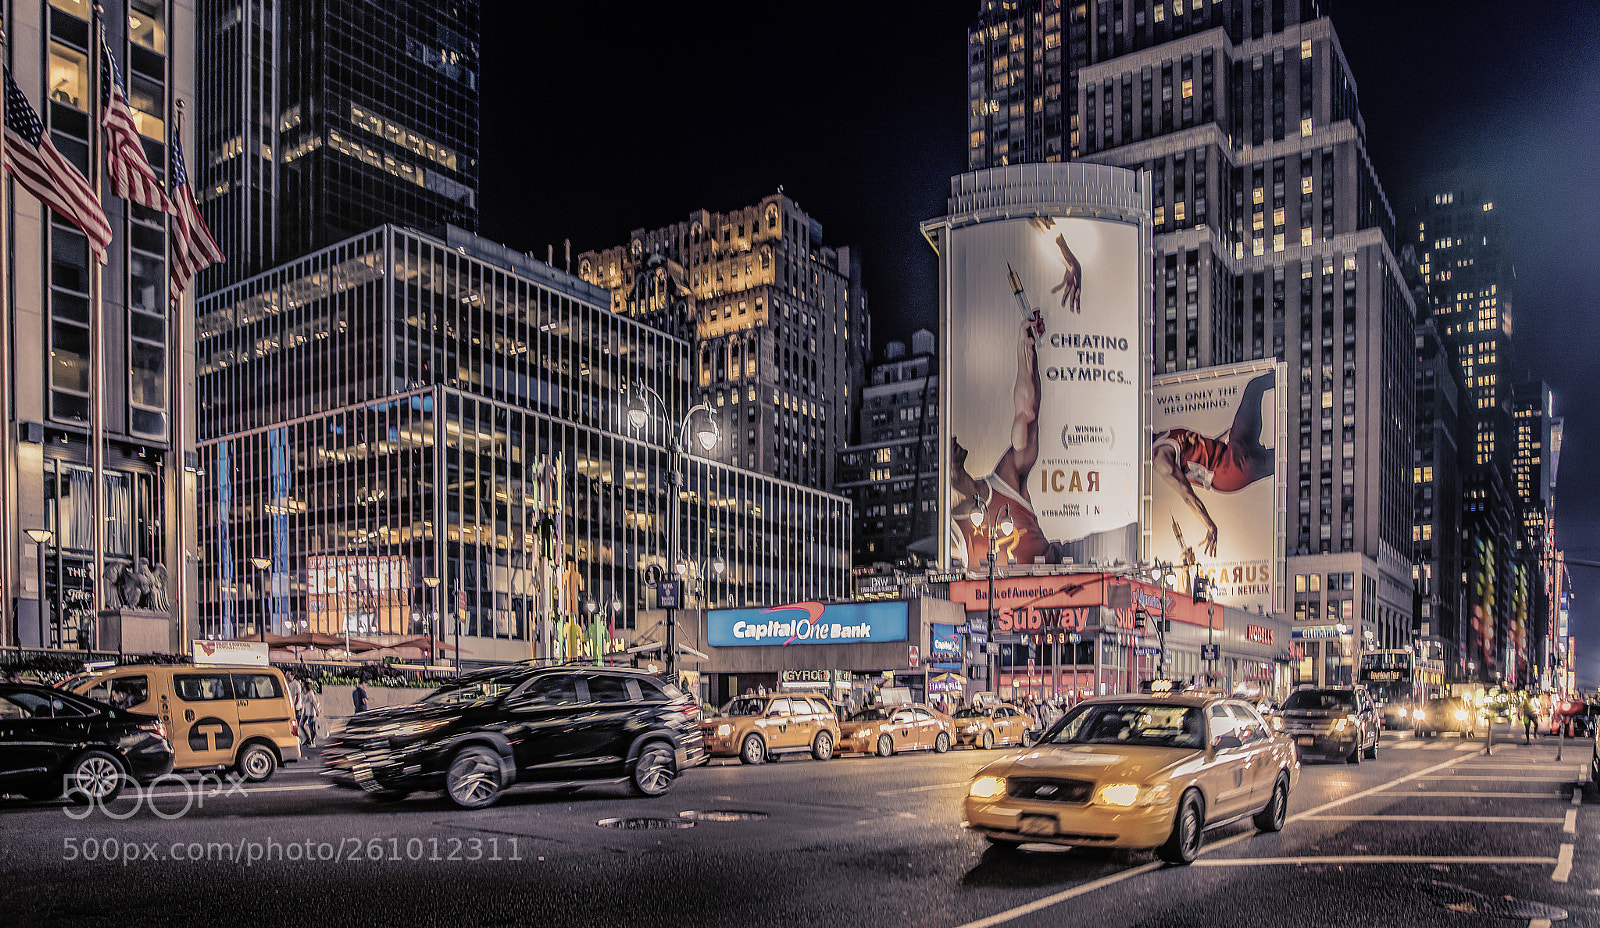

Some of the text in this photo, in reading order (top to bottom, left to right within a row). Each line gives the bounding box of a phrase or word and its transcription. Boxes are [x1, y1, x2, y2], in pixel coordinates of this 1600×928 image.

[1050, 333, 1128, 351] CHEATING
[1077, 350, 1105, 366] THE
[1156, 385, 1238, 405] WAS ONLY THE
[1074, 425, 1103, 433] WINNER
[1012, 585, 1054, 598] America
[1237, 584, 1269, 596] NETFLIX
[830, 622, 871, 638] Bank
